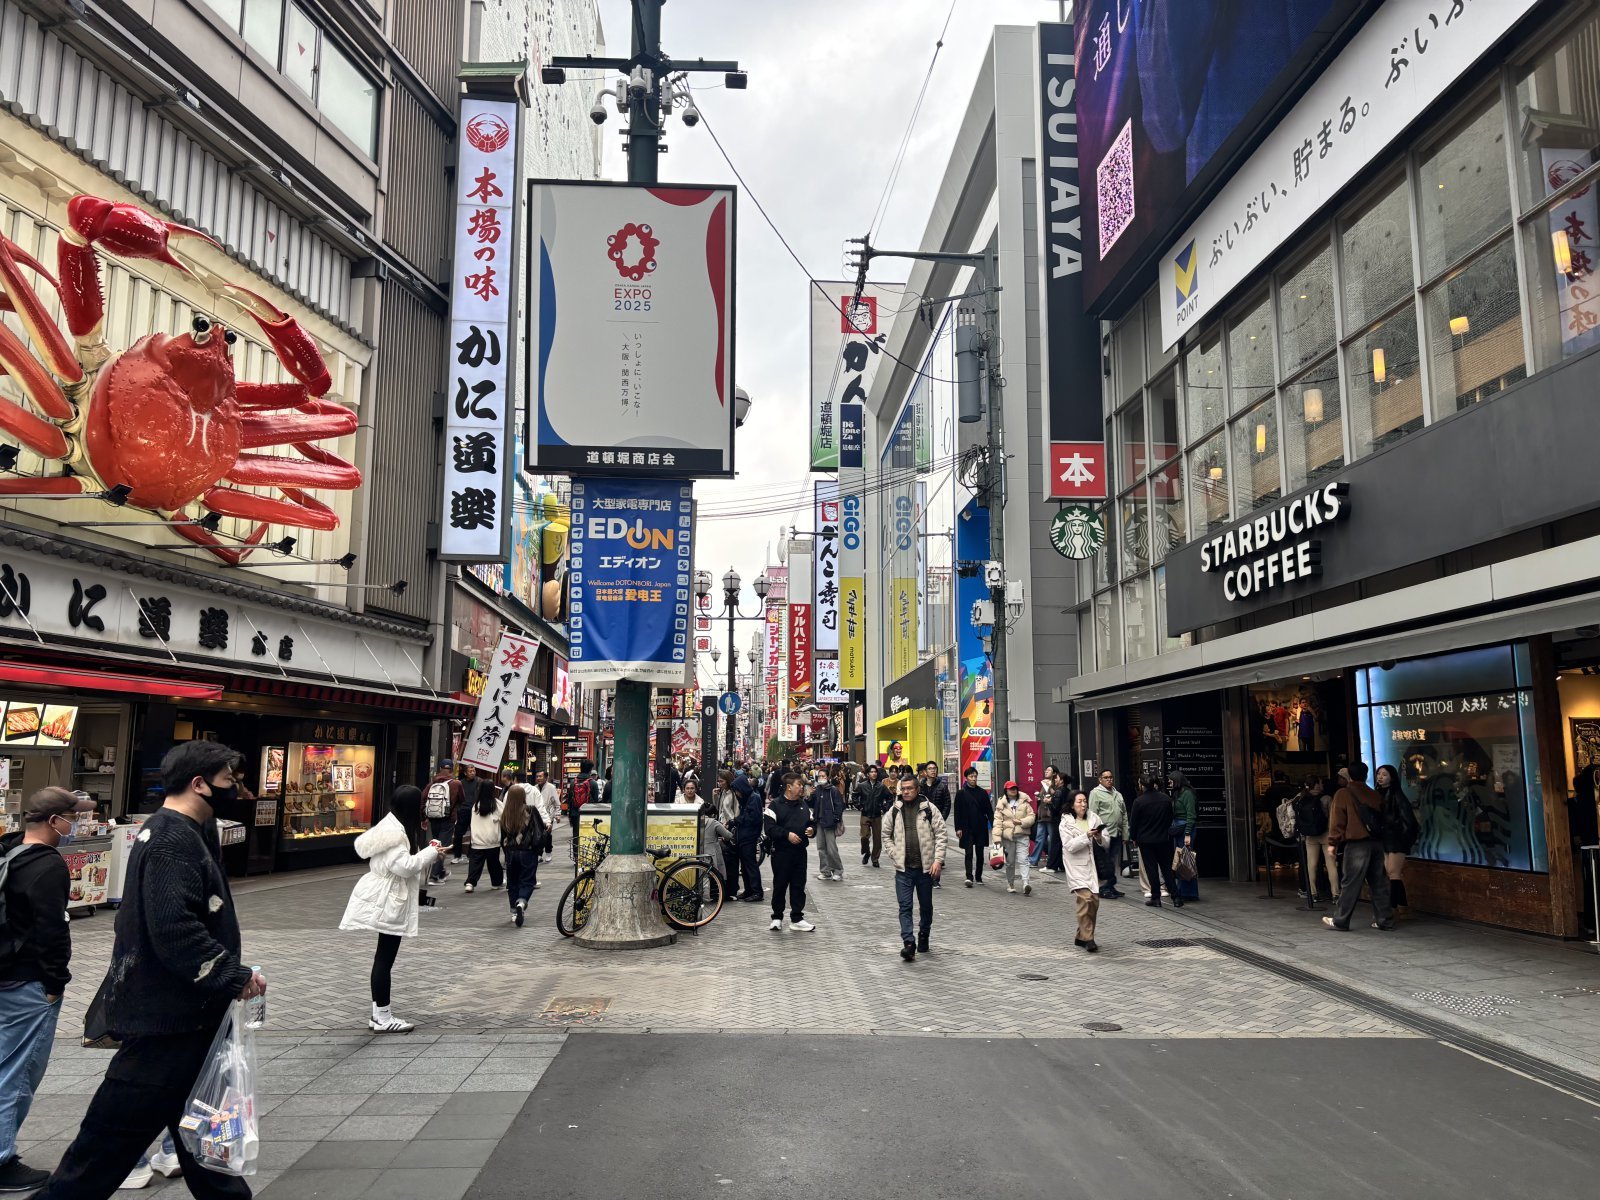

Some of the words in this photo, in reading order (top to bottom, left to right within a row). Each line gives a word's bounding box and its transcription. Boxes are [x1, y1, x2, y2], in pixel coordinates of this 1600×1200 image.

[464, 167, 504, 302] 本場の味
[614, 288, 652, 300] EXPO
[614, 300, 652, 312] 2025
[1176, 295, 1199, 327] POINT
[820, 401, 833, 449] 道頓堀店
[587, 450, 675, 466] 道頓堀商店会
[1059, 452, 1095, 488] 本
[592, 498, 672, 512] 大型家電専門店
[587, 517, 675, 550] EDION
[843, 495, 860, 550] GiGO
[1200, 482, 1340, 572] STARBUCKS
[599, 556, 661, 569] エディオン
[1223, 541, 1312, 602] COFFEE
[793, 605, 807, 682] ツルハドラッグ
[968, 728, 991, 736] GiGO
